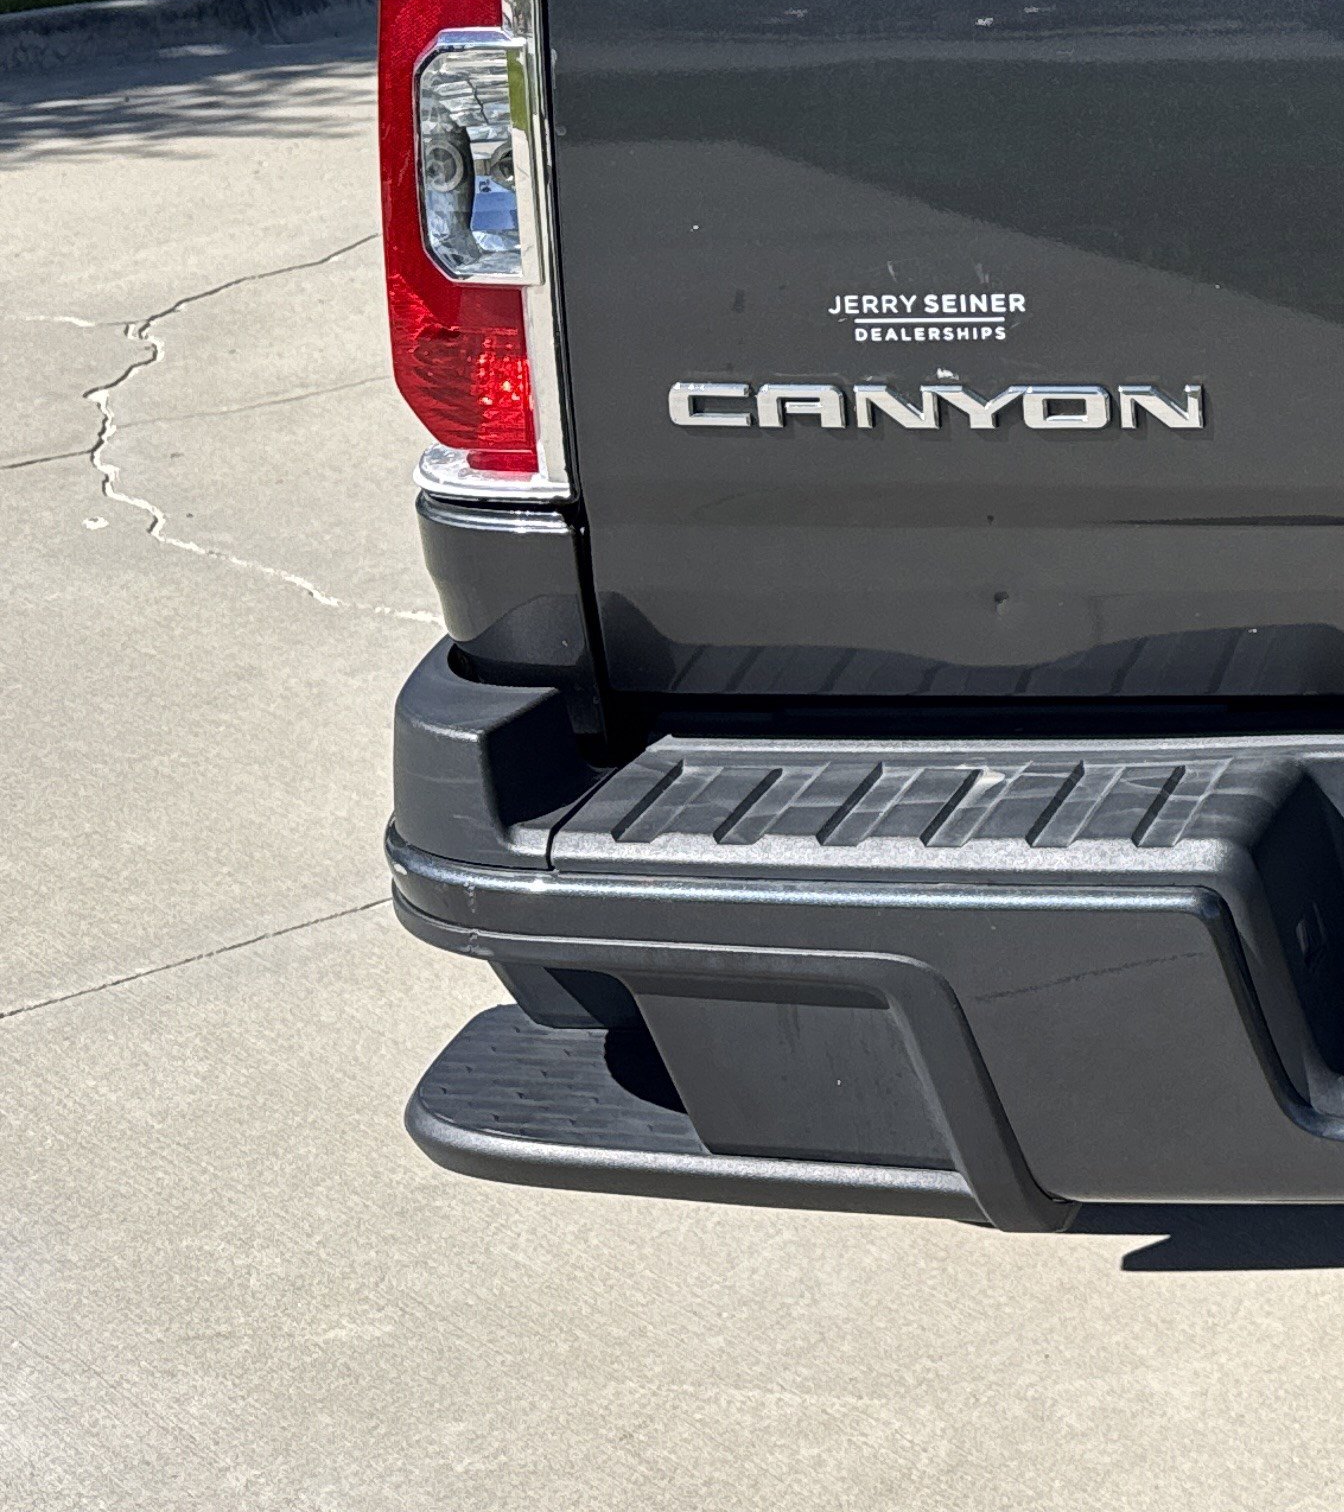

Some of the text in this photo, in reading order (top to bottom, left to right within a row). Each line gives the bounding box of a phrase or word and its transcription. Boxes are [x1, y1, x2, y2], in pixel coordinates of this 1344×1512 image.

[829, 293, 1026, 315] JERRY SEINER
[855, 326, 1006, 342] DEALERSHIPS
[668, 382, 1205, 429] CANYON
